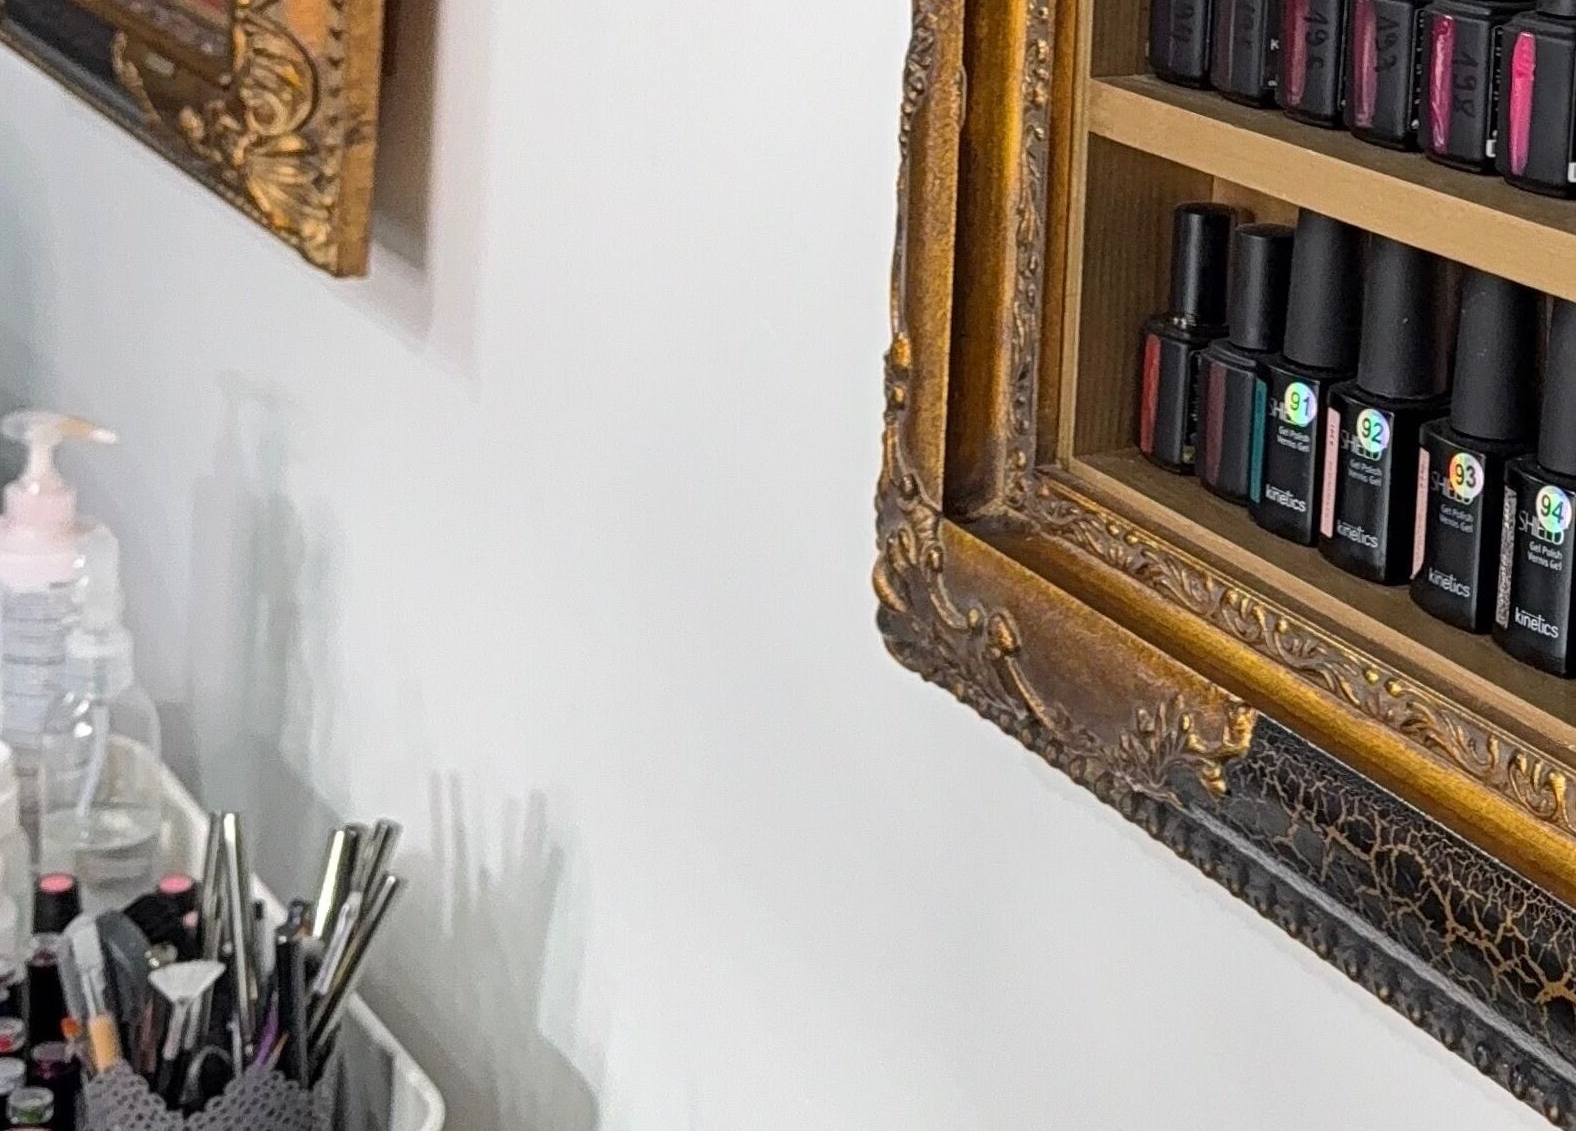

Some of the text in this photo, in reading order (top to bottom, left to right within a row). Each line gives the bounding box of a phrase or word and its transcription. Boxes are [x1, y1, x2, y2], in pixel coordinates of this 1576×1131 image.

[1290, 391, 1310, 416] 91
[1361, 417, 1384, 444] 92
[1455, 463, 1477, 488] 93
[1265, 483, 1306, 512] kinetics
[1541, 494, 1564, 524] 94
[1337, 519, 1379, 548] kinetics
[1429, 568, 1471, 598] kinetics
[1515, 607, 1559, 638] kinetics
